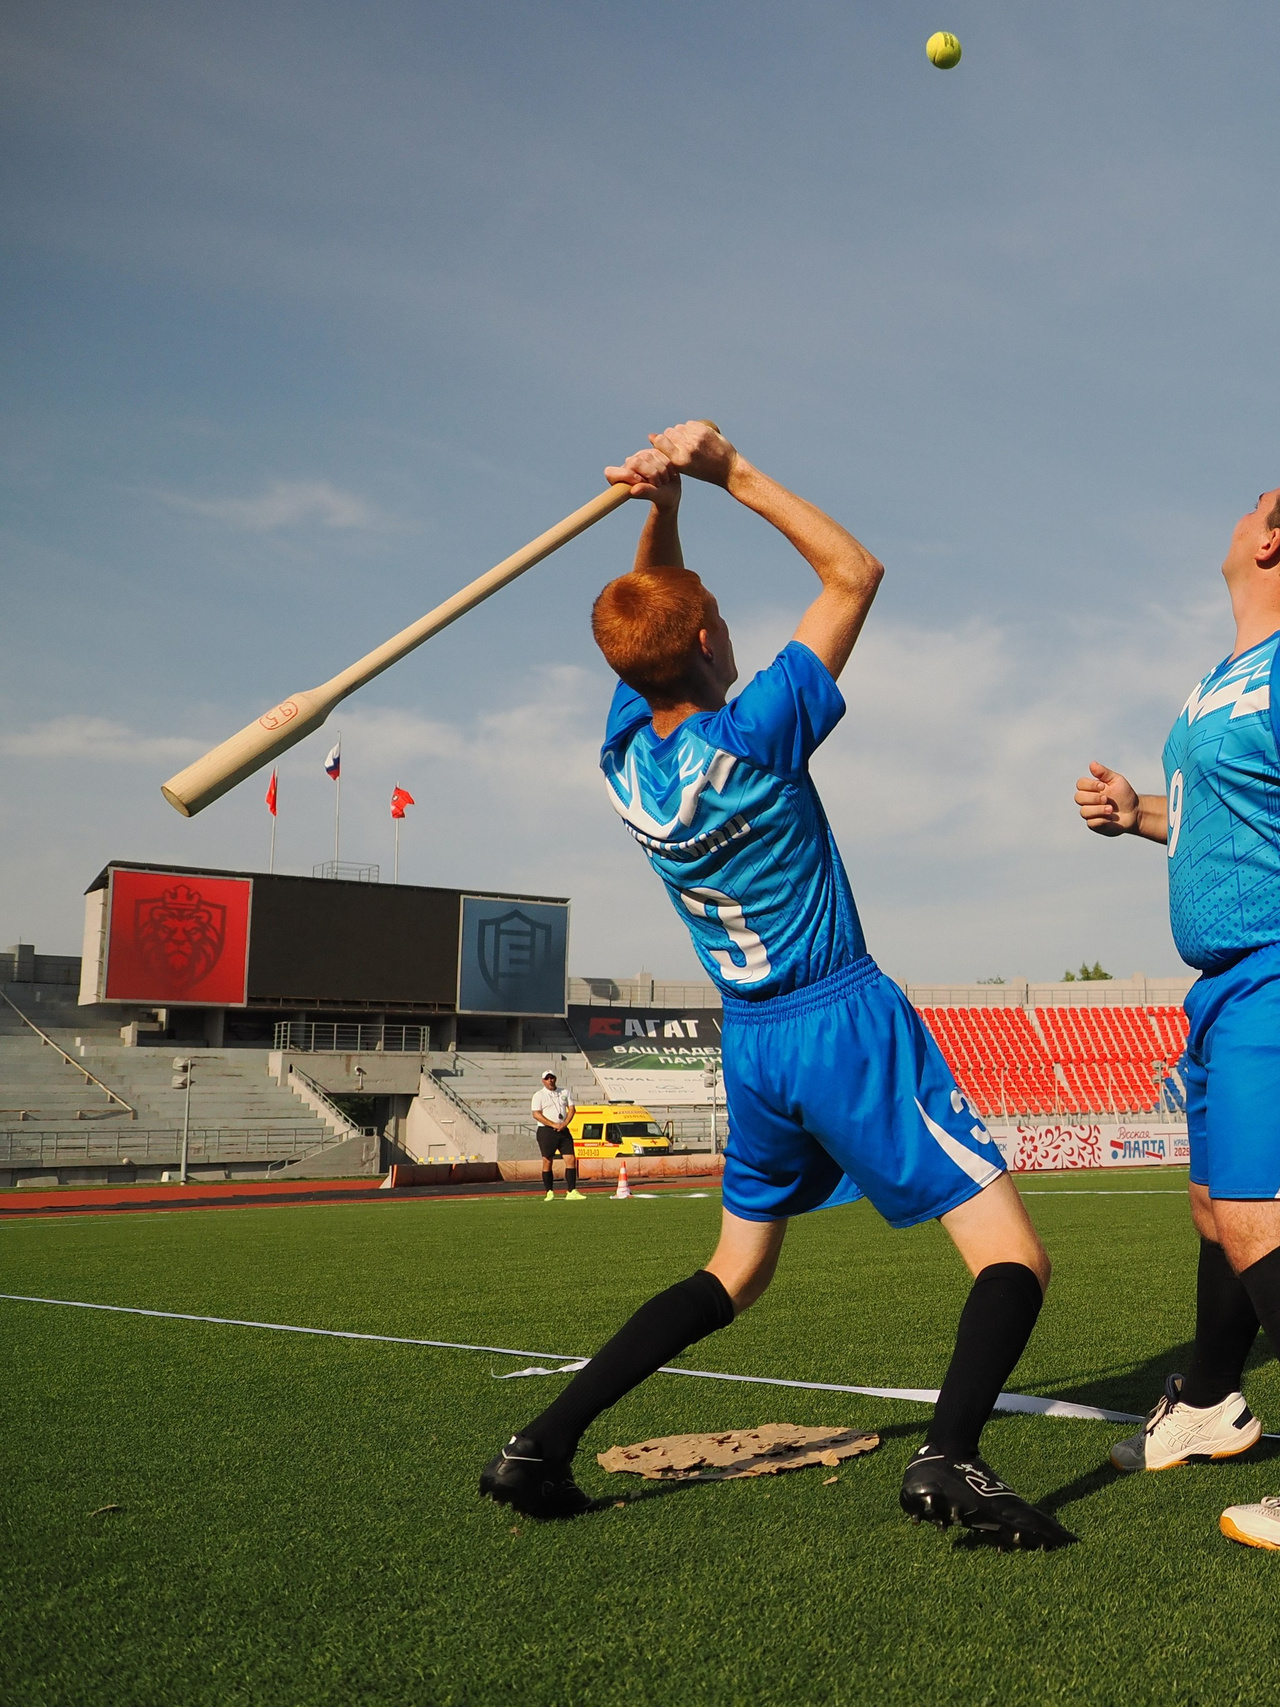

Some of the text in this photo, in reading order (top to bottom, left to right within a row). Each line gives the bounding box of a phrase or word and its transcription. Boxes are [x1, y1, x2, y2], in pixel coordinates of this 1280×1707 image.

[1168, 768, 1183, 857] 9
[680, 887, 771, 984] 3
[624, 1018, 699, 1038] АГАТ
[613, 1045, 659, 1054] ВАШ
[951, 1087, 991, 1145] 3
[1116, 1126, 1151, 1140] Русская
[577, 1148, 600, 1157] 203-03-03
[1122, 1140, 1166, 1159] ЛАПТА
